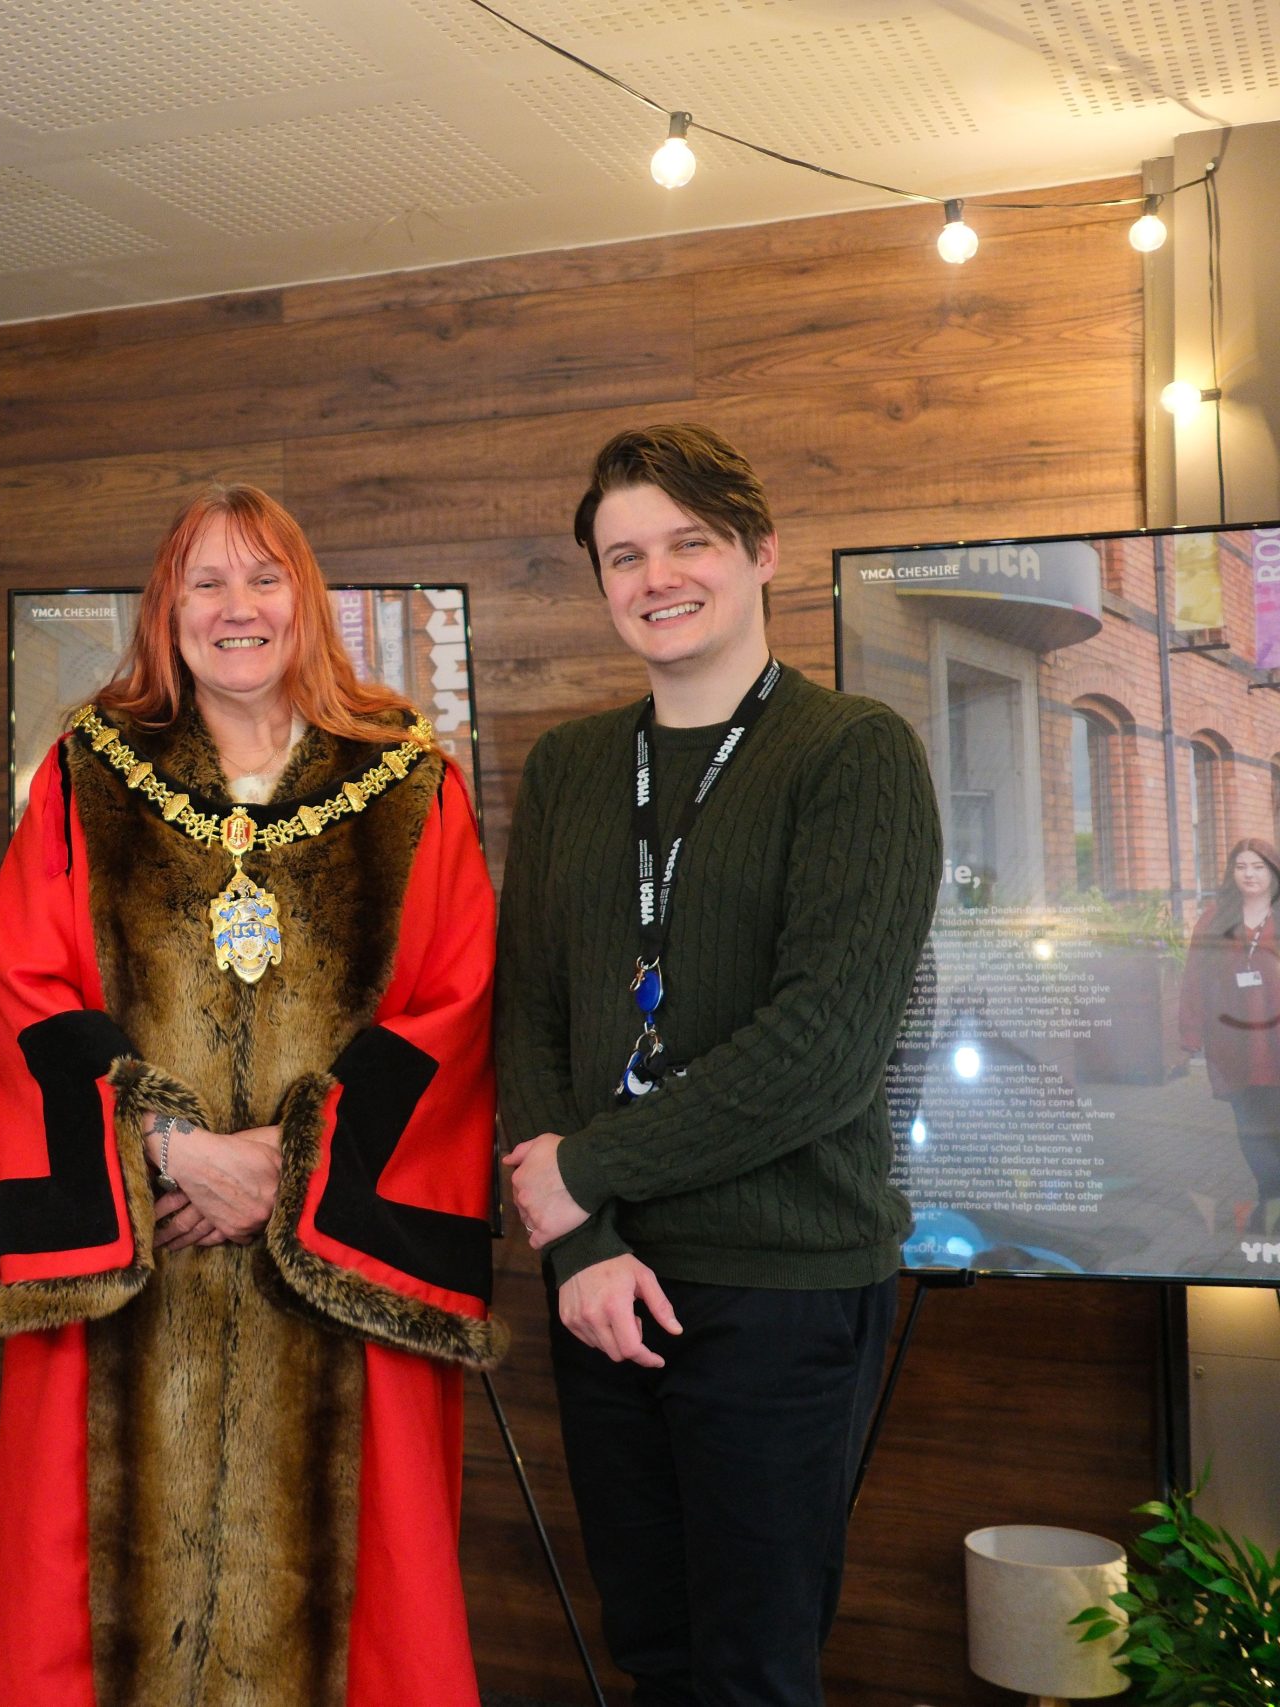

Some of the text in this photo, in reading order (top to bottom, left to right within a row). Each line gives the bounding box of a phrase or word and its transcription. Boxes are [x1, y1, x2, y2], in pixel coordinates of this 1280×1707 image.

[860, 564, 960, 580] YMCA CHESHIRE
[32, 607, 117, 617] YMCA CHESHIRE
[714, 726, 745, 763] YMCA
[637, 767, 650, 806] YMCA
[640, 882, 654, 925] YMCA
[1091, 984, 1110, 994] give
[1074, 995, 1106, 1005] Sophie
[1094, 1018, 1111, 1027] and
[1073, 1029, 1091, 1038] and
[1045, 1075, 1063, 1083] and
[987, 1109, 1012, 1118] YMCA
[1085, 1110, 1115, 1119] where
[1071, 1133, 1093, 1142] With
[1035, 1144, 1073, 1153] become
[1001, 1156, 1041, 1164] dedicate
[1044, 1156, 1059, 1164] her
[984, 1166, 999, 1175] the
[1030, 1167, 1072, 1176] darkness
[1074, 1168, 1092, 1177] she
[972, 1177, 994, 1186] from
[997, 1178, 1012, 1187] the
[1015, 1179, 1036, 1187] train
[1039, 1180, 1072, 1188] station
[1087, 1180, 1103, 1189] the
[976, 1190, 1017, 1200] powerful
[1019, 1191, 1063, 1200] reminder
[1077, 1191, 1103, 1200] other
[951, 1200, 991, 1210] embrace
[994, 1201, 1009, 1210] the
[1011, 1201, 1032, 1212] help
[1034, 1202, 1077, 1212] available
[1079, 1203, 1097, 1212] and
